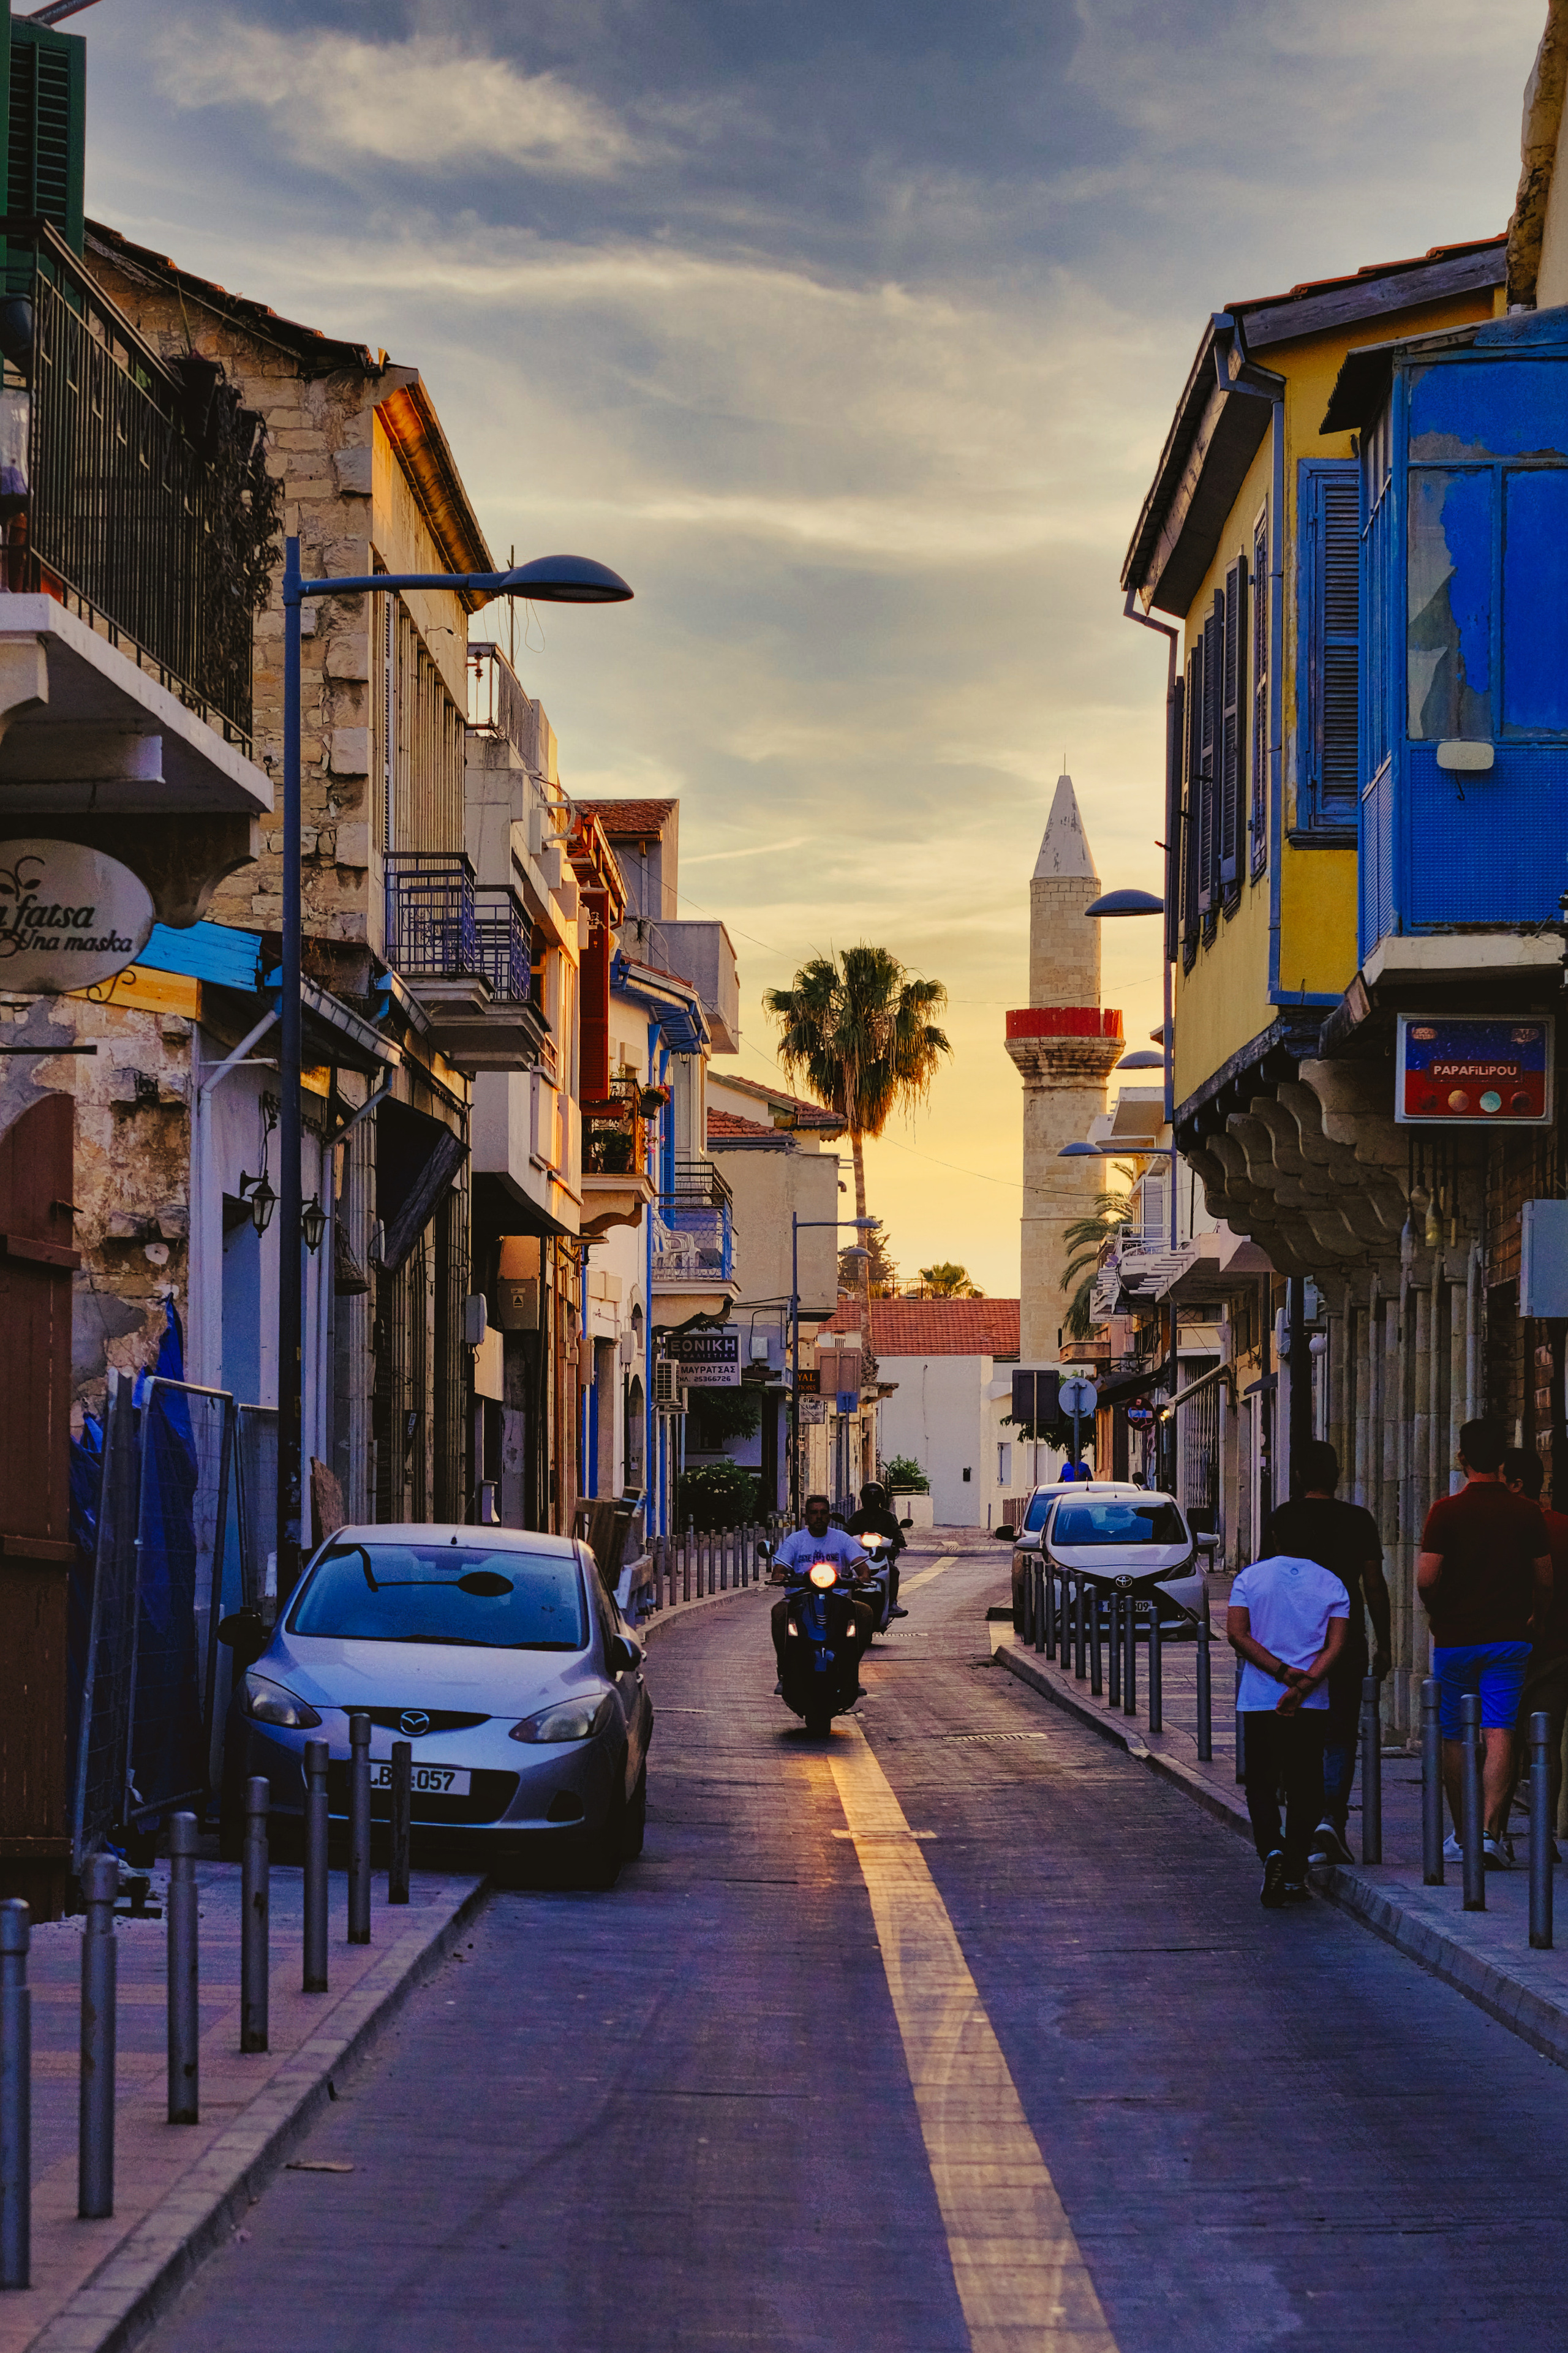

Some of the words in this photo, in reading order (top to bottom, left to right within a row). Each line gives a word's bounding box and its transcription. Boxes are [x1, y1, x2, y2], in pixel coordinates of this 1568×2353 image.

[13, 894, 95, 932] fatsa
[64, 929, 132, 952] maska
[797, 1372, 816, 1382] YAL
[417, 1770, 455, 1791] 057
